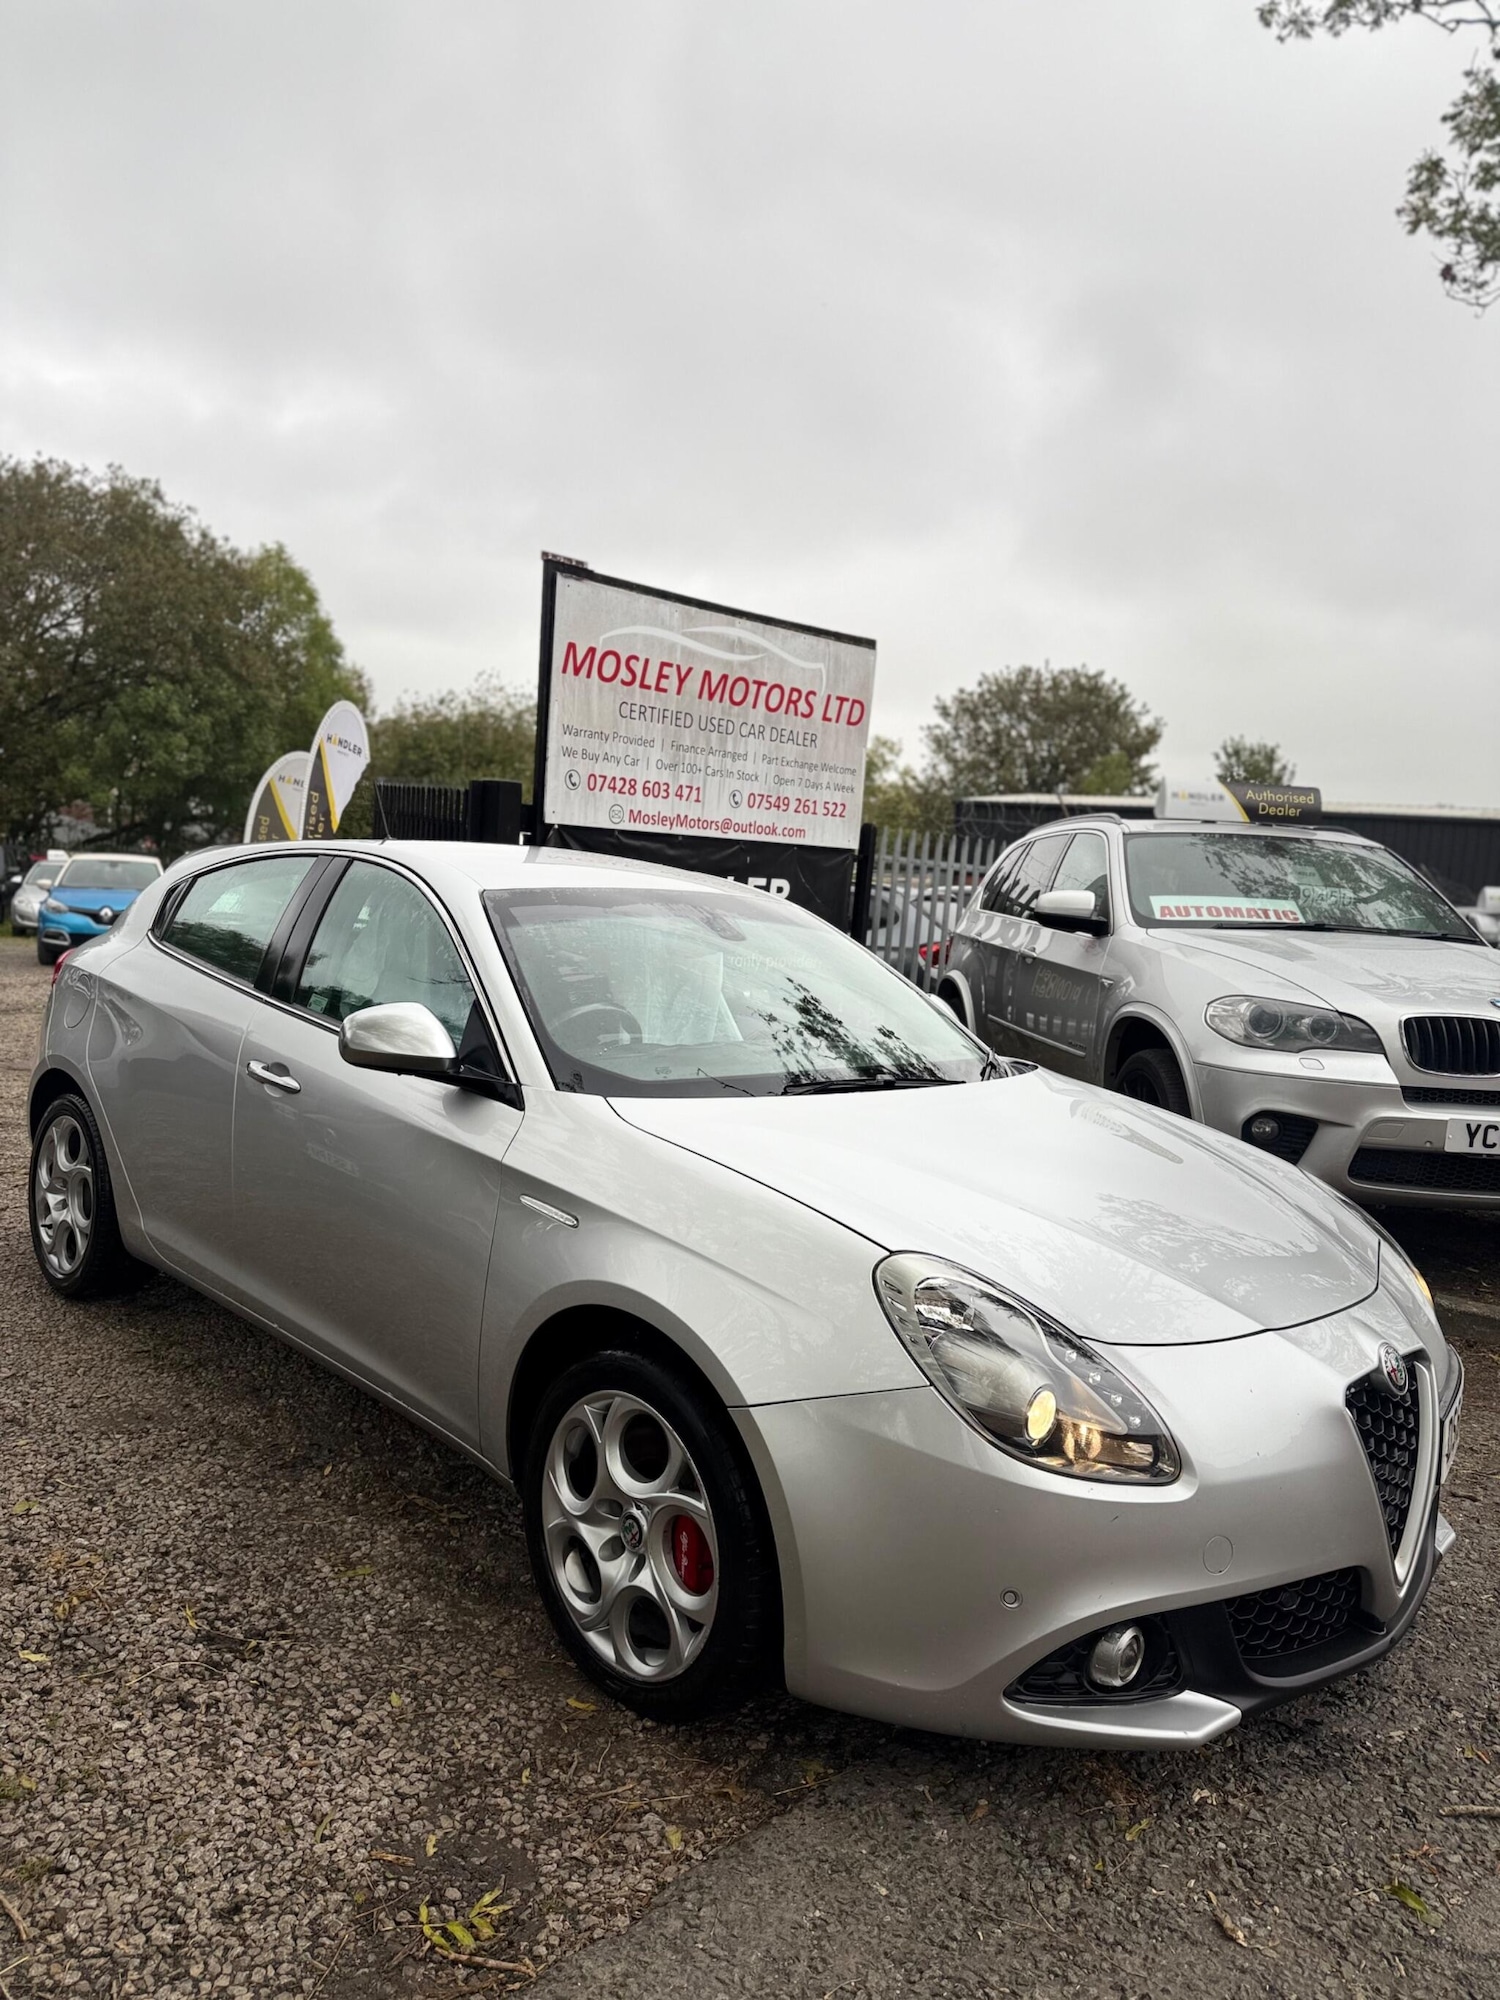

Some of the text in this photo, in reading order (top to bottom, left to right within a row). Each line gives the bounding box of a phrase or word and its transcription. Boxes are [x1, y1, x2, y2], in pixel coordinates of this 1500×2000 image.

[561, 641, 866, 727] MOSLEY MOTORS LTD
[618, 700, 818, 749] CERTIFIED USED CAR DEALER
[326, 733, 363, 758] HANDLER
[561, 723, 857, 777] Warranty Provided Finance Arranged Part Exchange Welcome
[561, 745, 856, 795] We Buy Any Car Over 100+ Cars In Stock Open 7 Days A Week
[587, 772, 847, 819] 07428 603 471 07549 261 522
[1245, 789, 1315, 805] Authorised
[1258, 802, 1302, 817] Dealer
[628, 808, 807, 839] MosleyMotors@outlook.com
[1159, 905, 1300, 922] AUTOMATIC
[1466, 1123, 1500, 1149] YC
